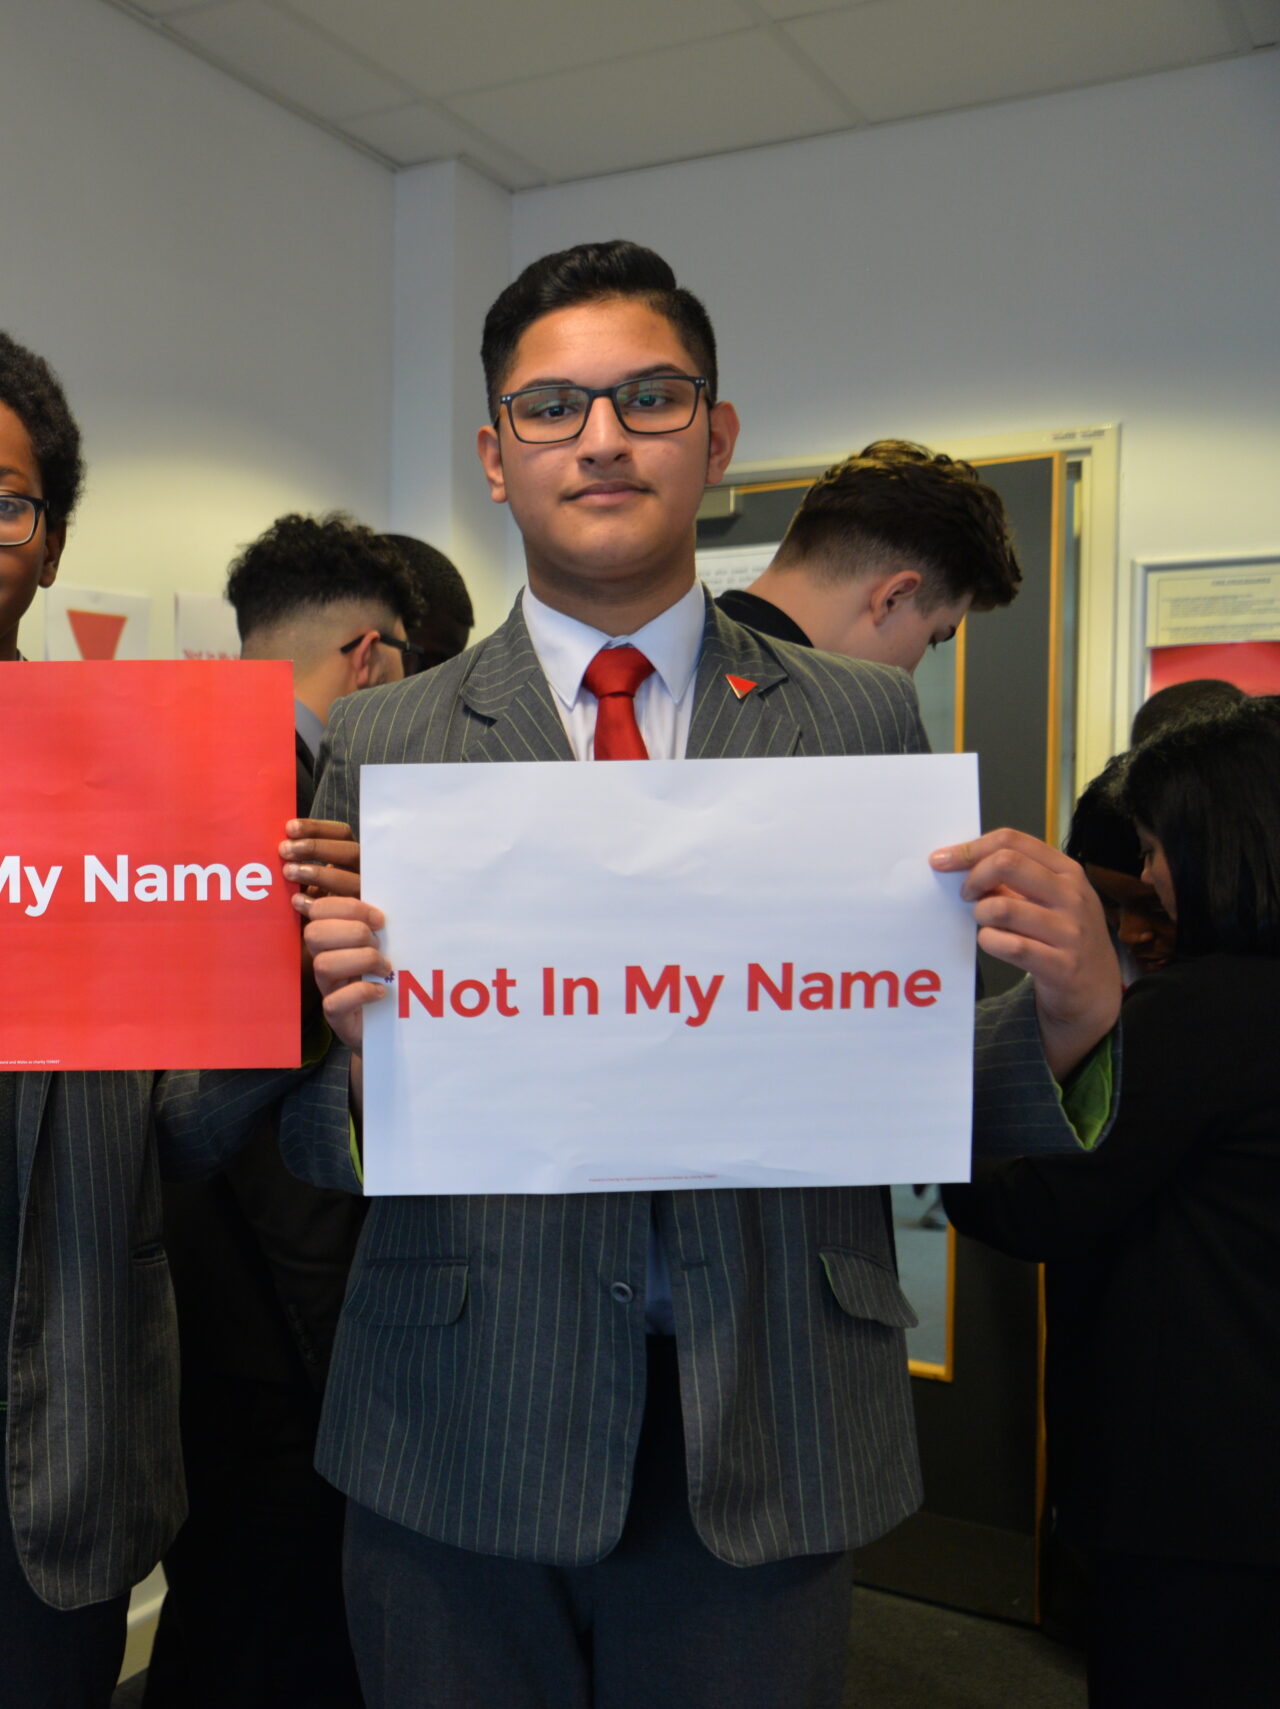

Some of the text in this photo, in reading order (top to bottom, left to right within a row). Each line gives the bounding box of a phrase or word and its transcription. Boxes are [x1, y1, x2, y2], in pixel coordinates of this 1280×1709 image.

[84, 854, 273, 902] Name
[543, 966, 599, 1016] In
[625, 964, 725, 1028] My
[747, 962, 942, 1012] Name
